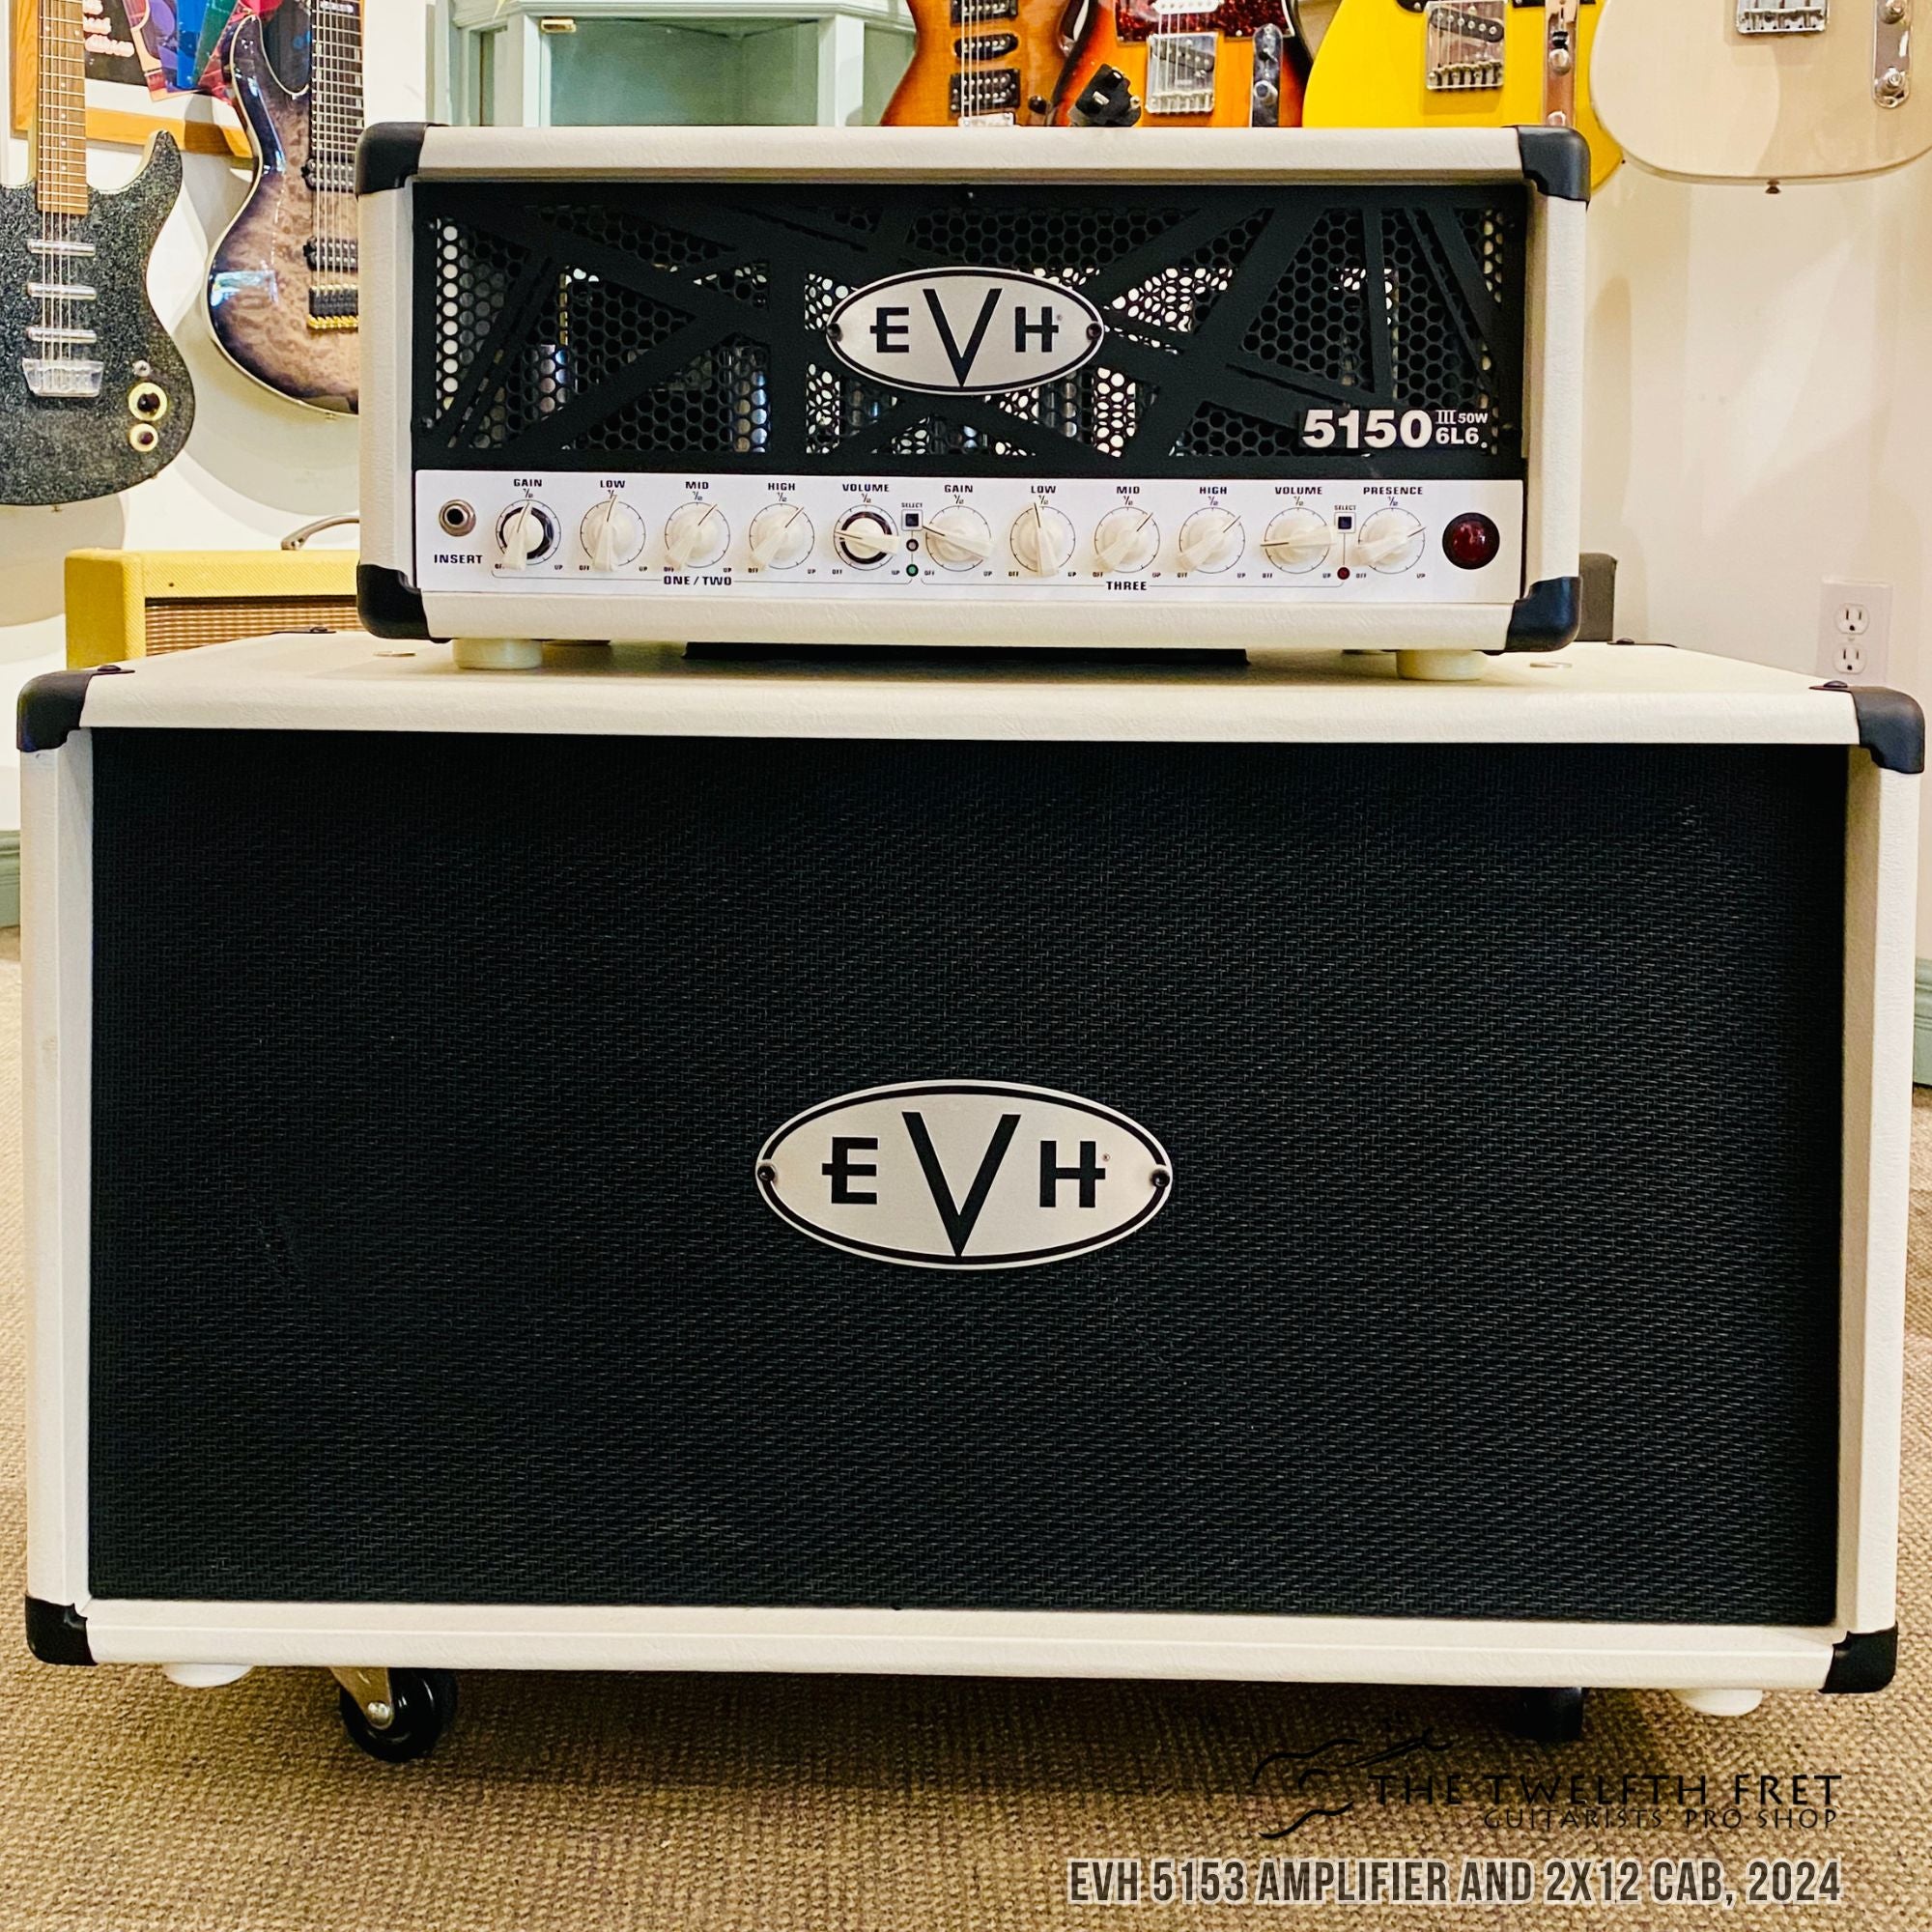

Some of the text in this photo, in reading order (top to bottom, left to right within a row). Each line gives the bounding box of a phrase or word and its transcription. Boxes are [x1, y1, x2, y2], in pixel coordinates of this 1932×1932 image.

[870, 289, 1059, 387] EVH
[1302, 410, 1489, 449] 5150 III 50W
[1435, 427, 1479, 444] 6L6
[434, 554, 483, 564] INSERT
[664, 576, 691, 584] ONE
[702, 577, 732, 585] TWO
[1106, 582, 1147, 590] THREE
[822, 1111, 1106, 1257] EVH
